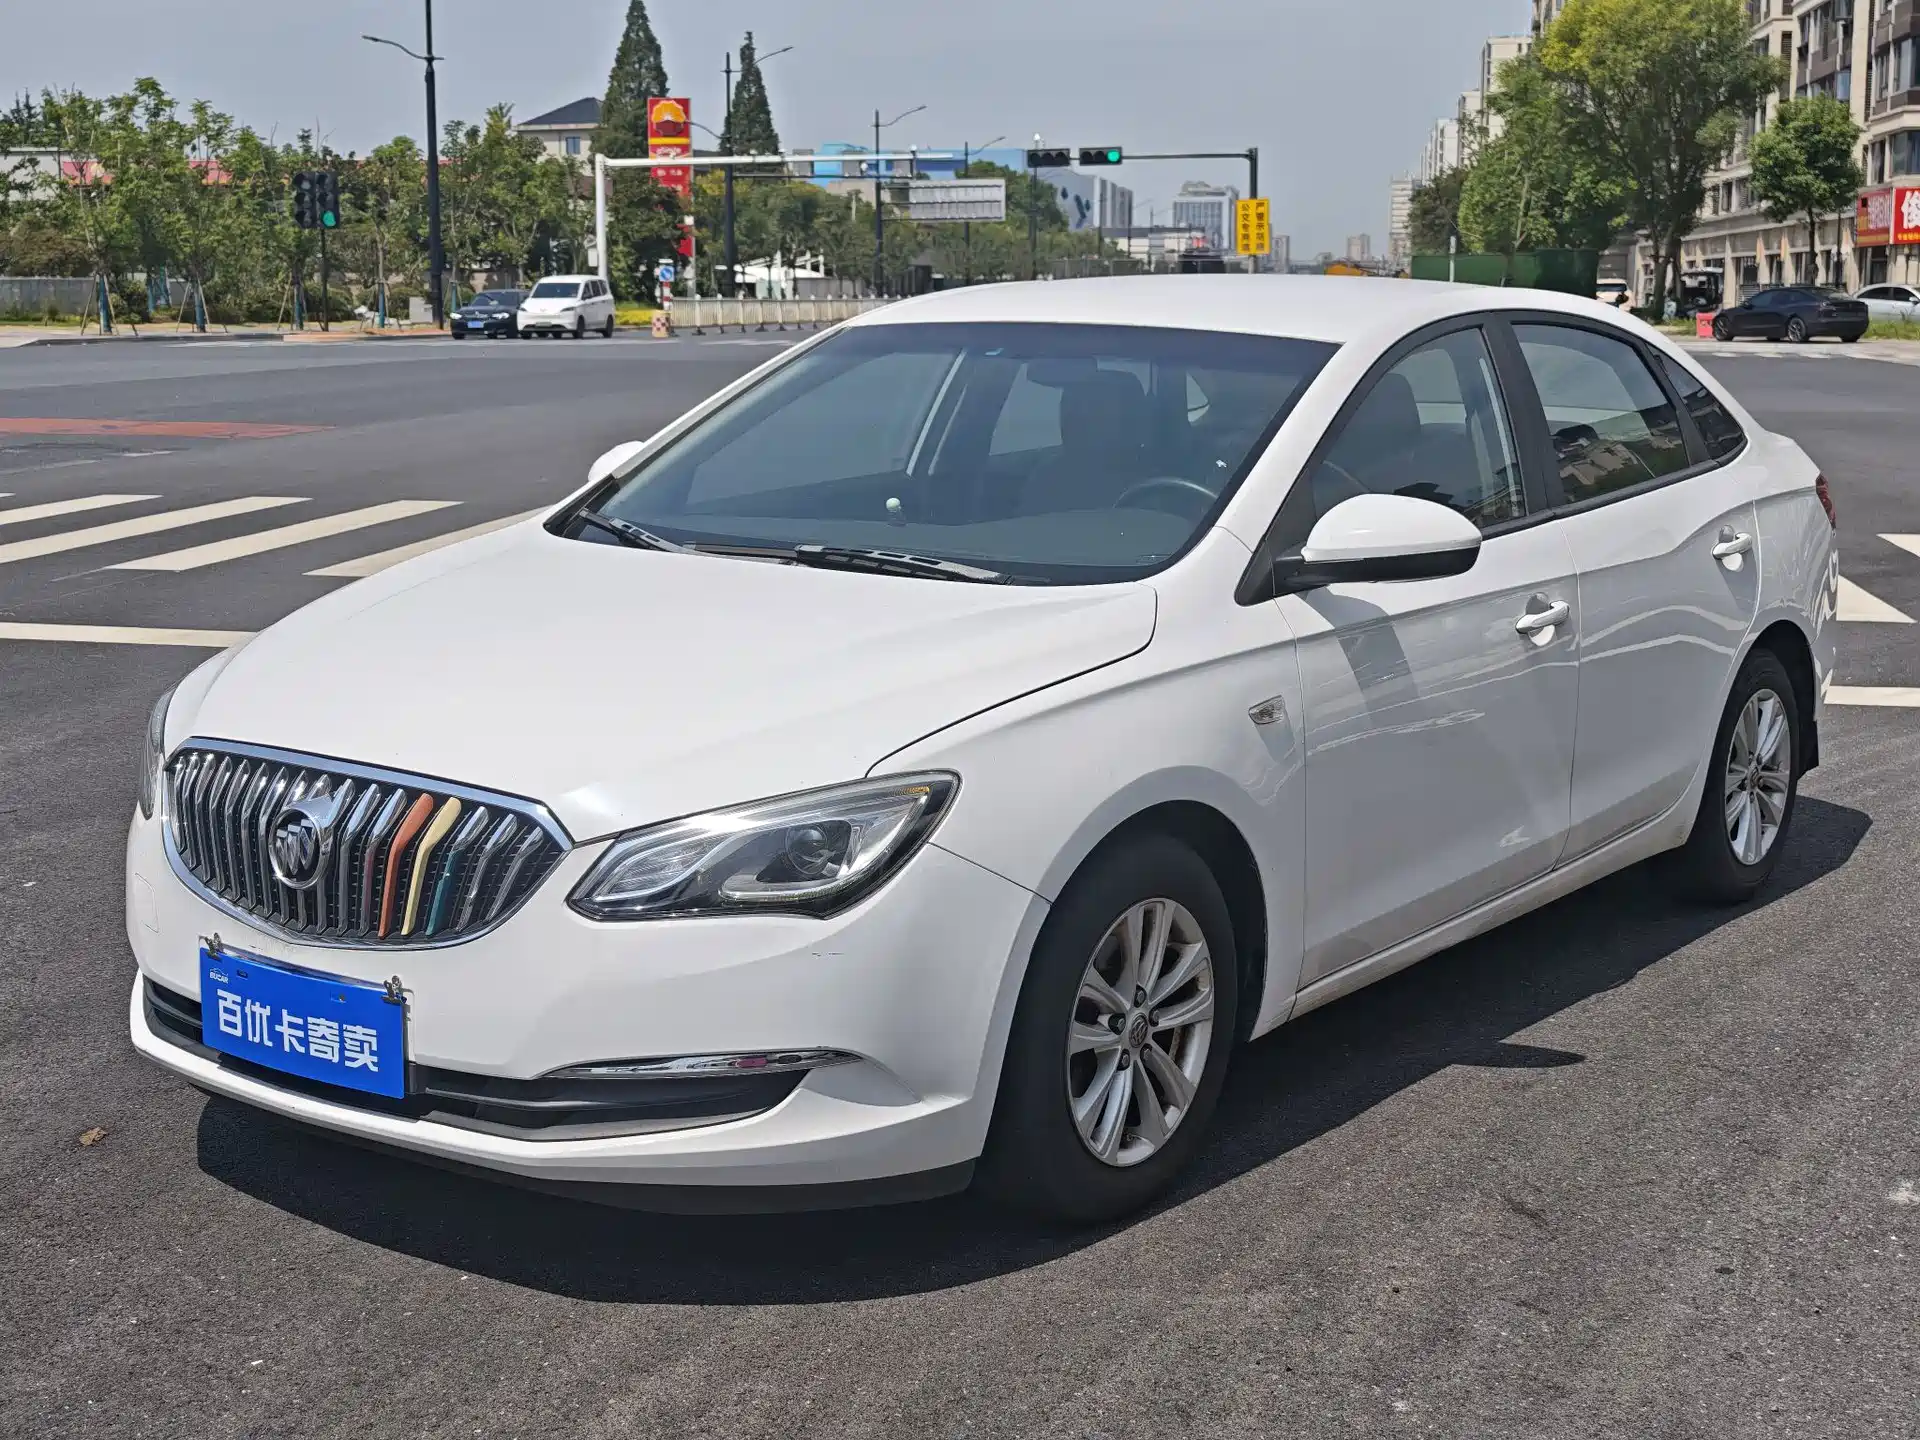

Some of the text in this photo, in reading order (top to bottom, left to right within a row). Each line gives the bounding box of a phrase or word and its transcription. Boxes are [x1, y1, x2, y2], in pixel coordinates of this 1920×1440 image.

[216, 988, 379, 1072] 百优卡寄卖
